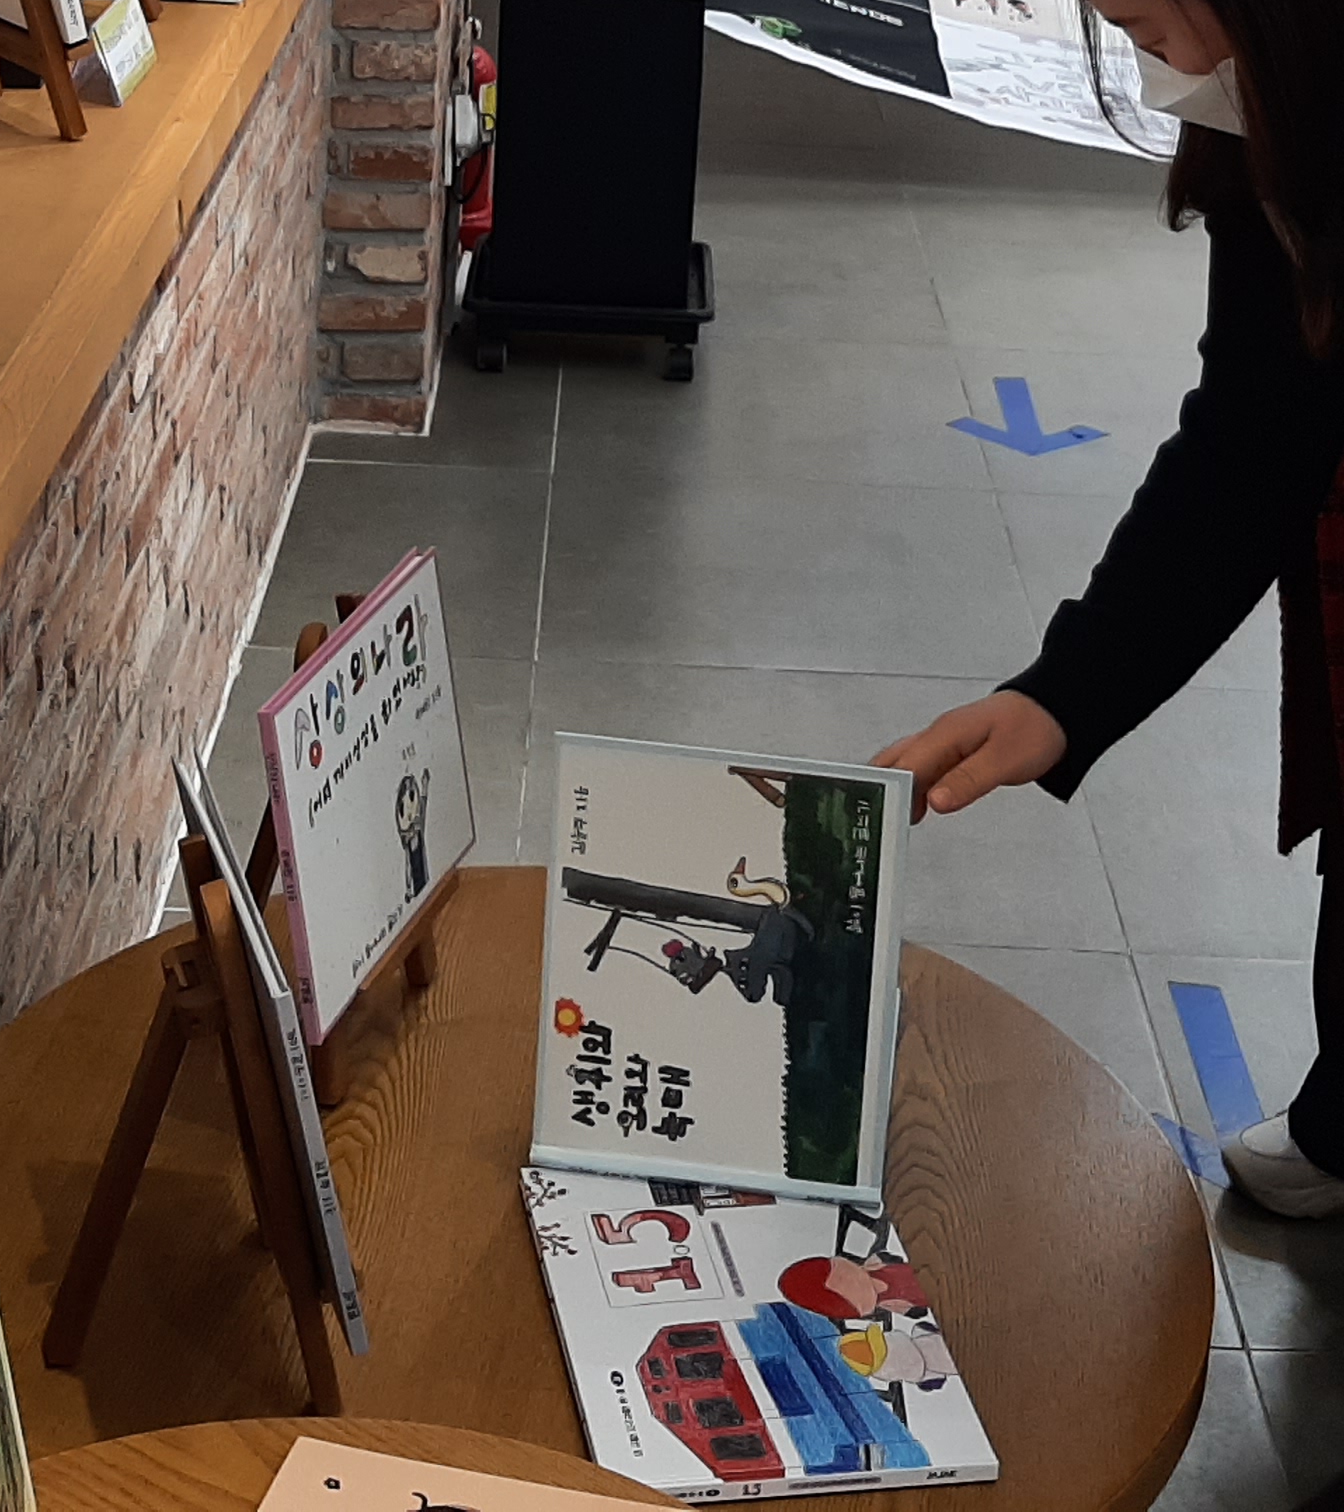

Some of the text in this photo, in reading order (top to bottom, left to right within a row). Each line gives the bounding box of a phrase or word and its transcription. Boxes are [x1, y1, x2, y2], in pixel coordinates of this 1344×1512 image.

[569, 1020, 613, 1127] 생쥐와
[616, 1053, 650, 1138] 오리와
[652, 1064, 695, 1141] 늑대
[591, 1209, 701, 1293] 1.5
